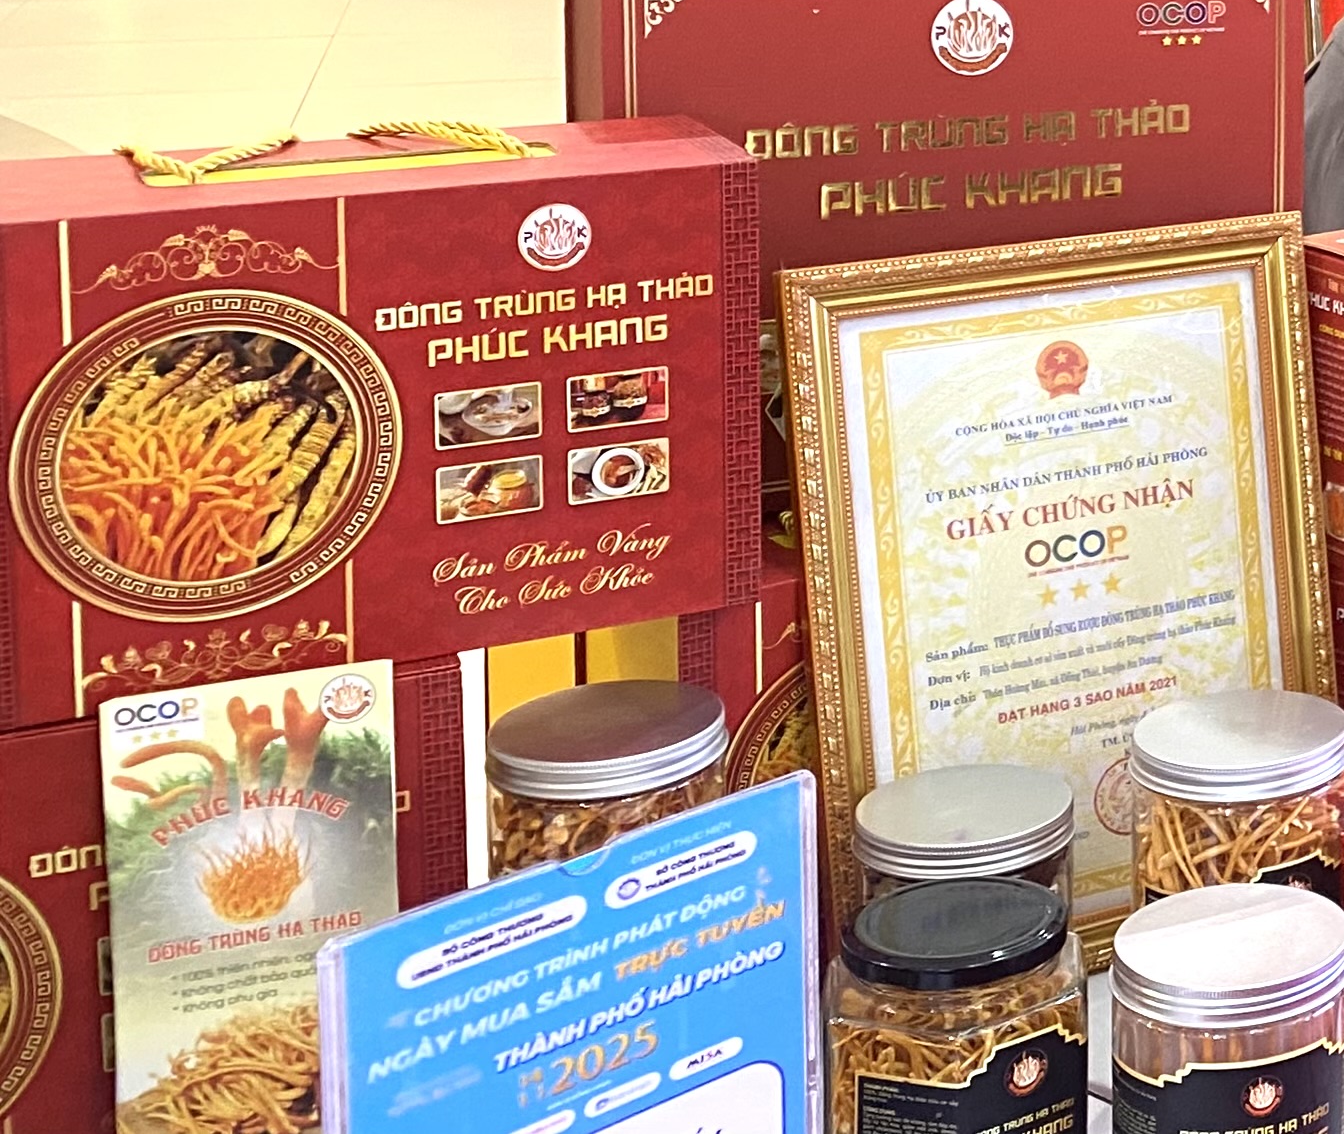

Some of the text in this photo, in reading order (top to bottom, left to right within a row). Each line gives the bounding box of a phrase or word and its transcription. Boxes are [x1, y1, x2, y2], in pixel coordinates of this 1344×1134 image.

[1136, 0, 1226, 26] OCOP
[745, 98, 1191, 160] ĐÔNG TRÙNG HẠ THẢO
[820, 163, 1123, 221] PHÚC KHANG
[375, 272, 714, 331] ĐÔNG TRÙNG HẠ THẢO
[428, 314, 668, 368] PHÚC KHANG
[955, 422, 988, 438] CỘNG
[1122, 398, 1146, 411] VIỆT
[1148, 394, 1172, 406] NAM
[948, 485, 976, 500] BAN
[980, 477, 1020, 496] NHÂN
[1023, 472, 1052, 488] DÂN
[1055, 464, 1102, 482] THÀNH
[1106, 457, 1133, 474] PHỐ
[1162, 446, 1208, 464] PHÒNG
[946, 478, 1196, 541] GIẤY CHỨNG NHẬN
[432, 522, 671, 587] Sản Phẩm Vàng
[1025, 525, 1128, 568] OCOP
[454, 586, 511, 615] Cho
[518, 575, 572, 609] Sức
[114, 697, 199, 727] OCOP
[998, 676, 1177, 725] ĐẠT HẠNG 3 SAO NĂM 2021
[242, 785, 353, 821] KHANG
[29, 844, 101, 879] ĐÔN
[413, 883, 748, 1027] CHƯƠNG TRÌNH PHÁT ĐỘNG
[367, 1029, 455, 1084] NGÀY
[460, 1003, 532, 1046] MUA
[535, 970, 601, 1016] SẮM
[614, 940, 688, 982] TRỰC
[494, 940, 786, 1074] THÀNH PHỐ HẢI PHÒNG
[551, 1020, 661, 1095] 2025
[686, 1046, 723, 1069] MISA
